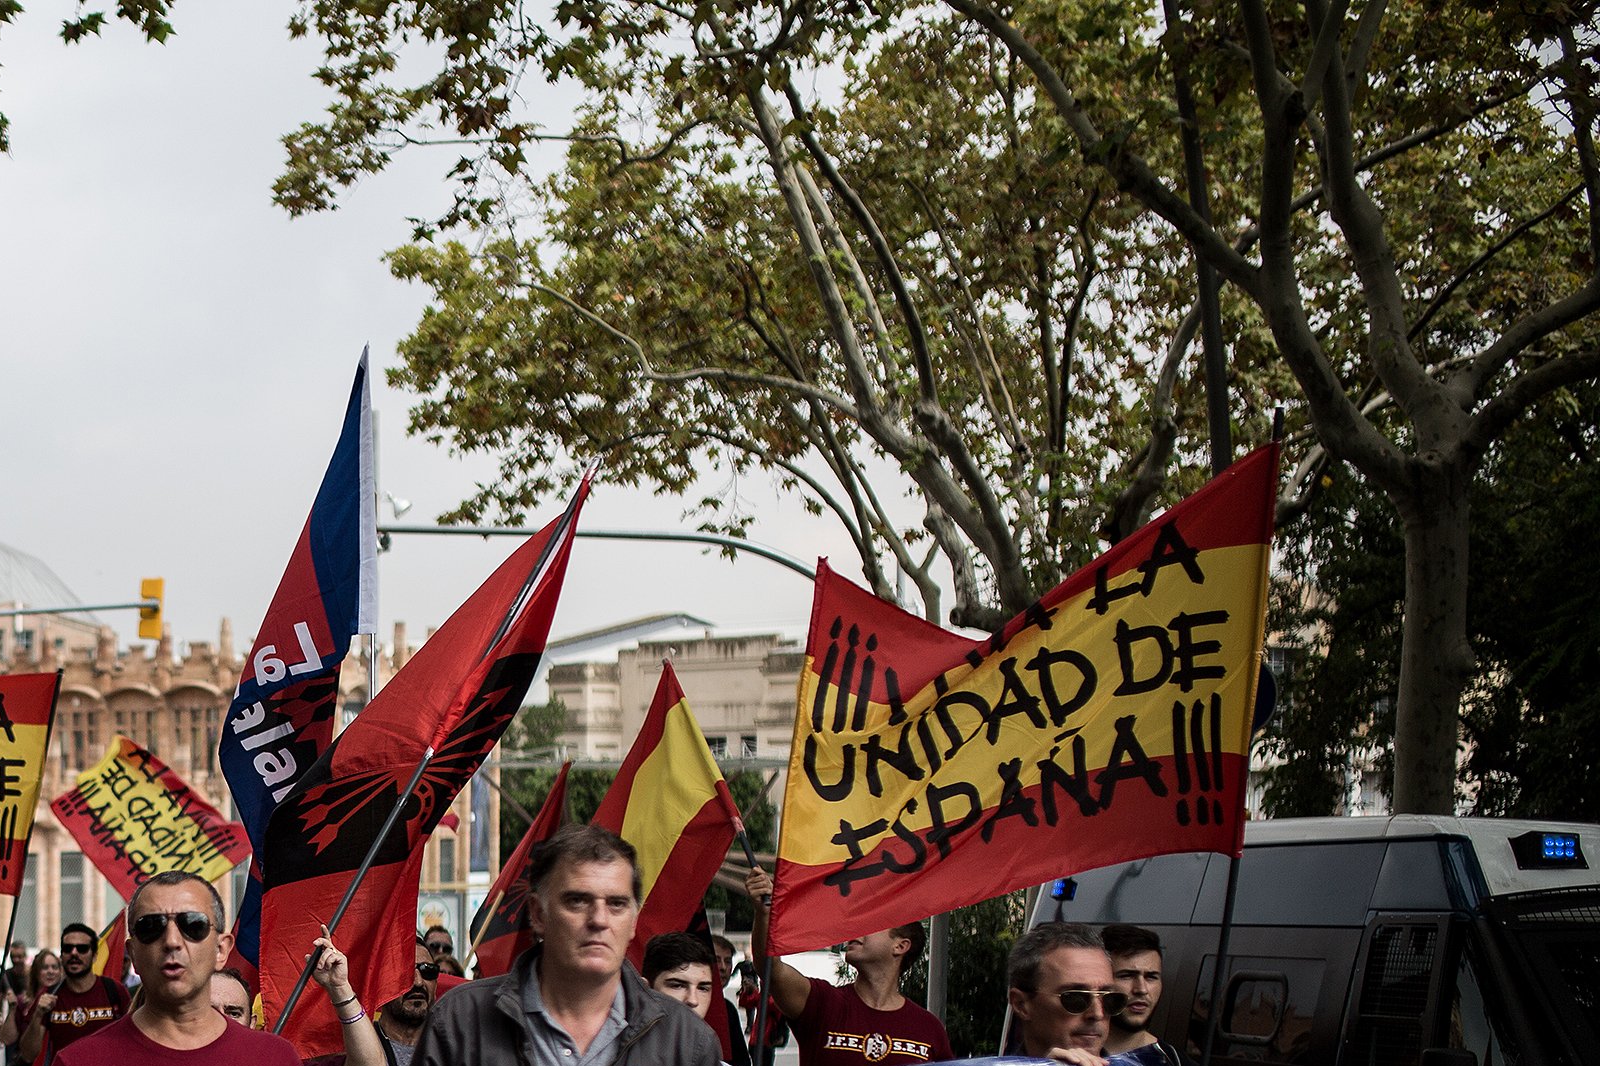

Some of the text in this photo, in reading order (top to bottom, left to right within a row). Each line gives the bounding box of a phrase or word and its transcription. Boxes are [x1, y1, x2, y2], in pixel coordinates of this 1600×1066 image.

[1085, 520, 1205, 614] LA
[803, 610, 1230, 802] UNIDAD DE
